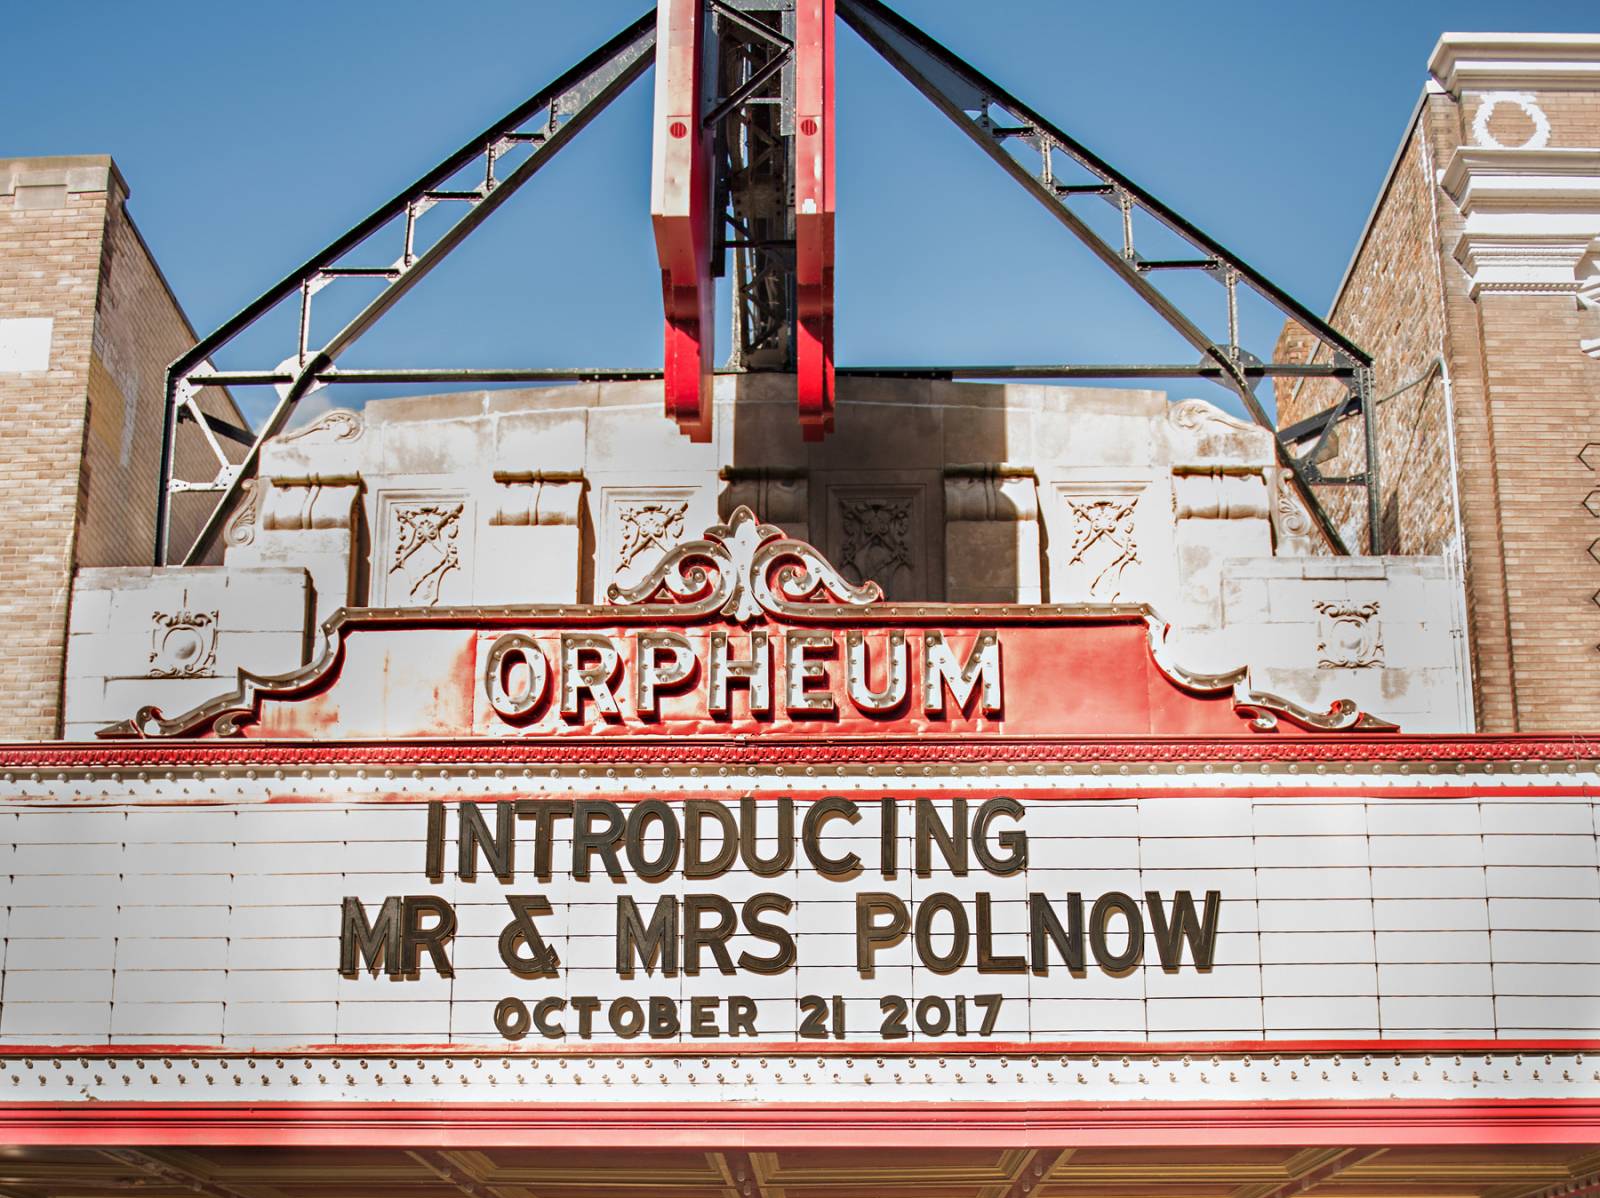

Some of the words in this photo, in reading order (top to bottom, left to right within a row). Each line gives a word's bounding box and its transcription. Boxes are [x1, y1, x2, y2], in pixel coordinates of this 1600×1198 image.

[484, 629, 1004, 723] ORPHEUM
[426, 796, 1028, 880] INTRODUCING
[339, 894, 455, 977] MR
[499, 894, 559, 977] &
[616, 892, 797, 977] MRS
[856, 890, 1221, 978] POLNOW
[494, 994, 758, 1039] OCTOBER
[799, 994, 845, 1038] 21
[880, 993, 1003, 1037] 2017
